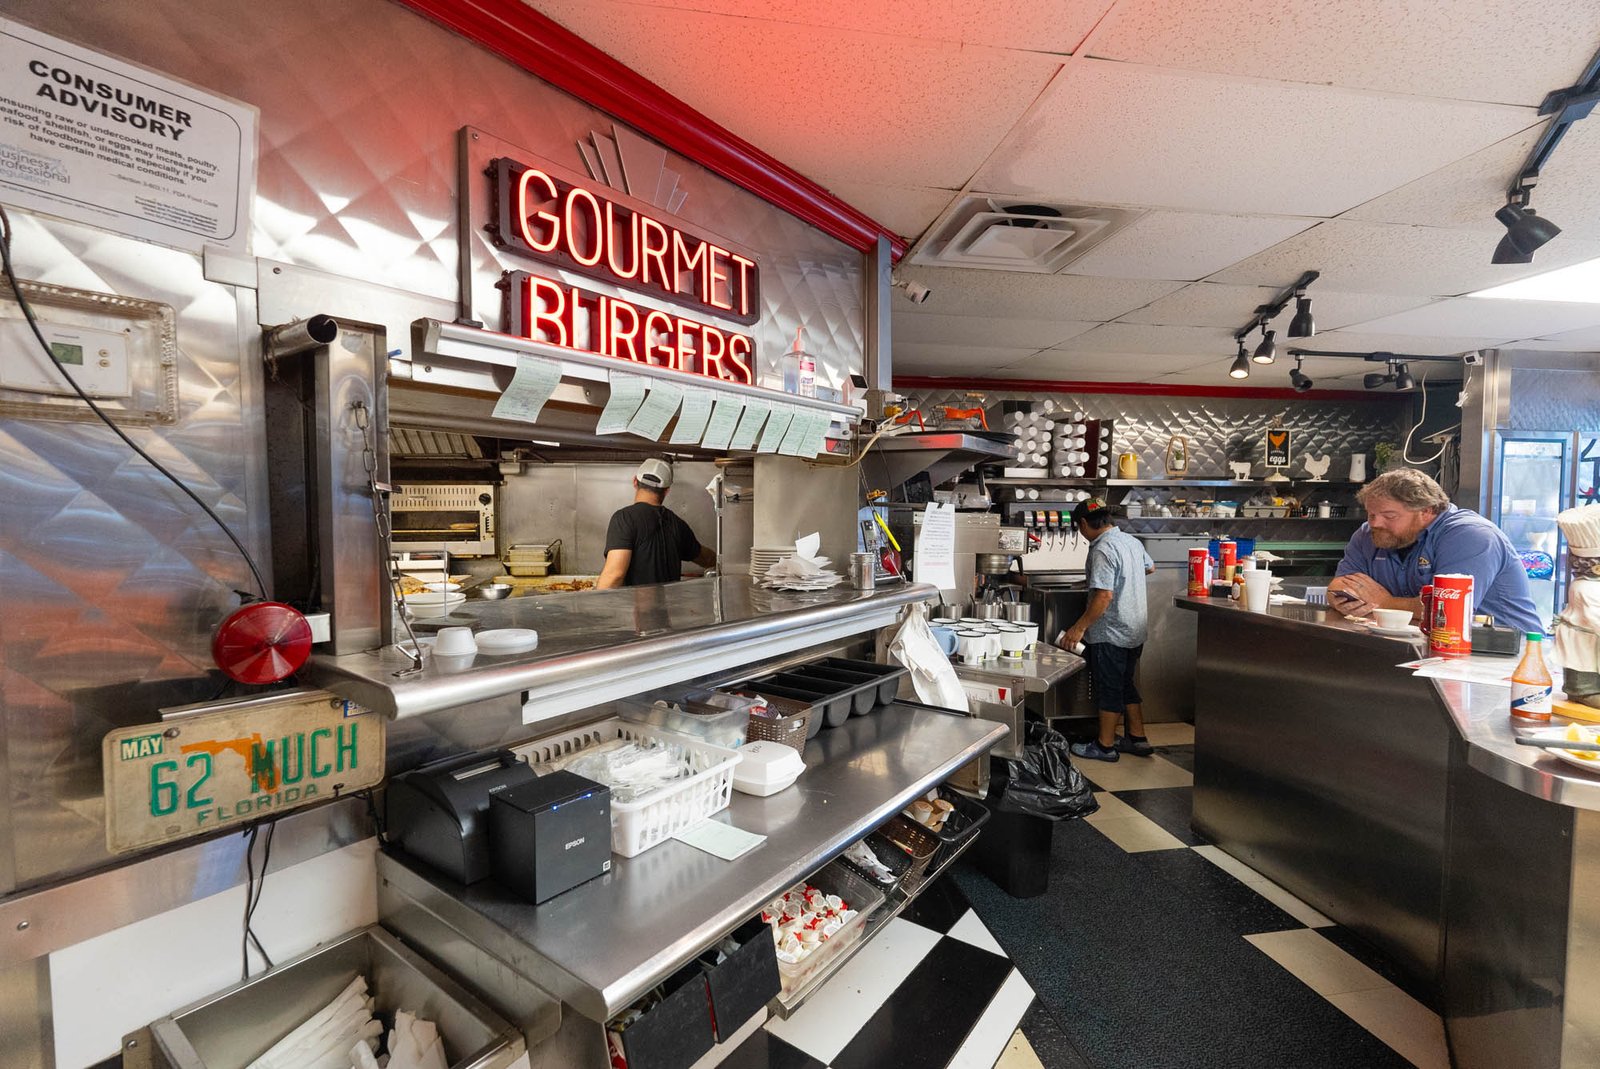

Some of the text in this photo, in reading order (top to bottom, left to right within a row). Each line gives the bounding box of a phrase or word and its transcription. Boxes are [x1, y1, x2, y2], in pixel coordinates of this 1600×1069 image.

[29, 60, 192, 127] CONSUMER
[36, 83, 184, 141] ADVISORY
[4, 115, 25, 127] risk
[28, 123, 39, 132] of
[42, 127, 96, 149] foodborne
[135, 157, 181, 176] especially
[191, 174, 207, 184] you
[30, 132, 56, 145] have
[58, 142, 94, 157] certain
[96, 153, 135, 169] medical
[54, 113, 74, 124] raw
[90, 125, 153, 149] undercooked
[0, 150, 50, 170] usiness
[0, 159, 71, 184] rofessional
[94, 135, 105, 143] or
[108, 139, 132, 152] eggs
[134, 148, 153, 159] may
[156, 154, 194, 170] increase
[196, 167, 215, 178] your
[518, 169, 755, 316] GOURMET
[529, 275, 753, 386] BURGERS
[1269, 456, 1287, 465] eggs
[122, 736, 162, 760] MAY
[150, 723, 358, 818] 62 MUCH
[197, 783, 319, 825] FLORIDA
[565, 837, 585, 851] EPSON
